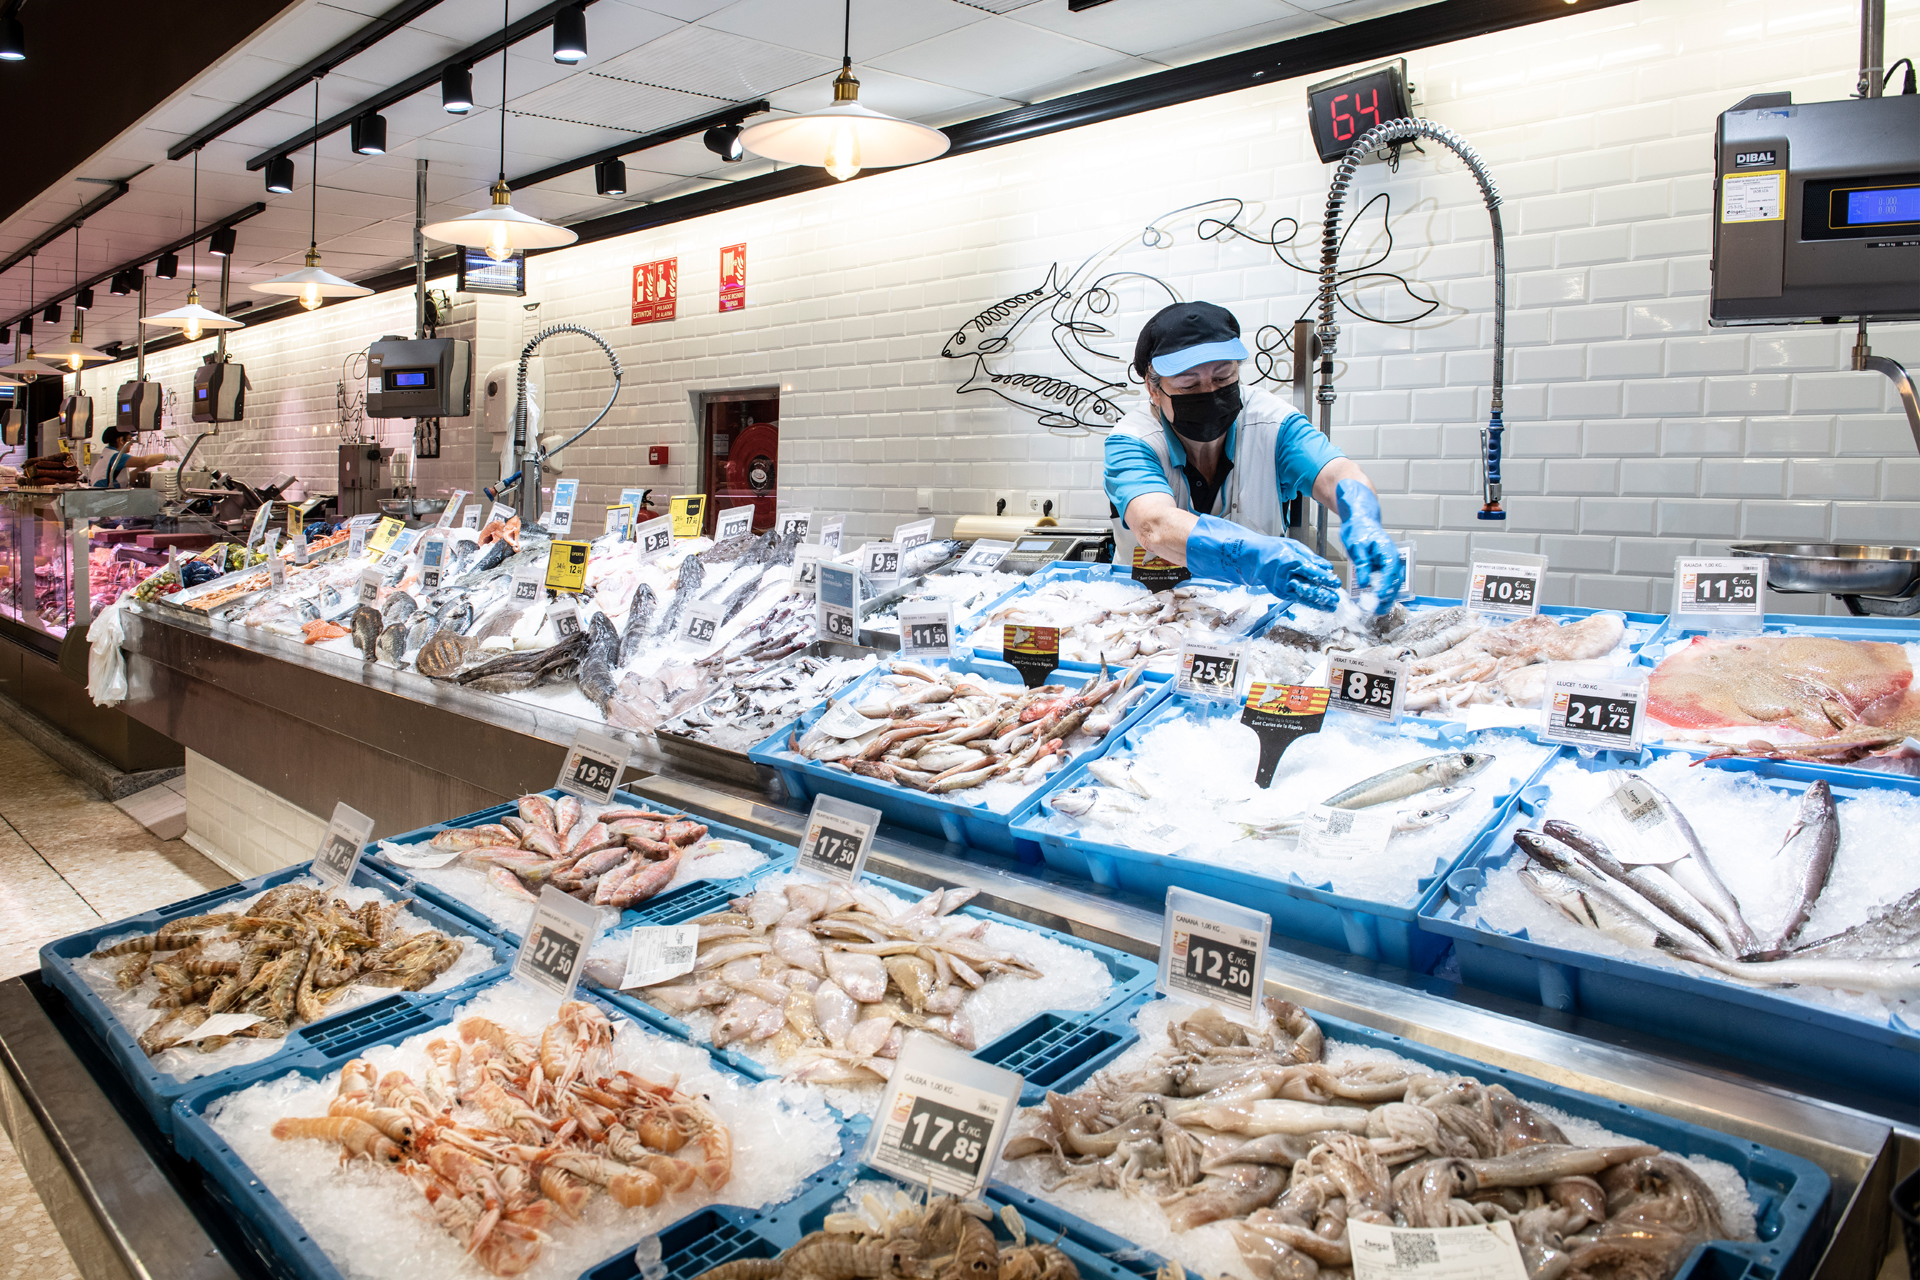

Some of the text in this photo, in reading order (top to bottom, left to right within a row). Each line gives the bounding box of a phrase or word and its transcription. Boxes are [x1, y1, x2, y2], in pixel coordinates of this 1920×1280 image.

[1331, 88, 1380, 141] 64
[1737, 152, 1774, 163] DIBAL
[633, 310, 652, 319] EXTINTOR
[657, 303, 673, 311] PULSADOR
[786, 520, 807, 535] 895
[648, 535, 669, 551] 9,95
[873, 553, 897, 572] 9,95
[517, 585, 536, 598] 25,99
[1486, 581, 1532, 603] 10,95
[1699, 580, 1754, 602] 11,50
[560, 619, 579, 635] 6,95
[691, 619, 713, 639] 5,99
[828, 614, 852, 636] 6,99
[913, 629, 946, 647] 11,50
[1192, 660, 1234, 684] 2550
[1347, 672, 1392, 705] 8,95
[1568, 702, 1631, 731] 21,75
[579, 763, 611, 788] 19,50
[328, 843, 351, 870] 47,50
[819, 835, 855, 865] 17,50
[1175, 915, 1220, 933] CANANA 1,00 KG
[535, 936, 572, 975] 27,50
[1190, 946, 1251, 988] 12,50 €/KG.
[904, 1073, 954, 1095] GALERA 1,00 KG
[912, 1111, 982, 1164] 17,85 €/KG.
